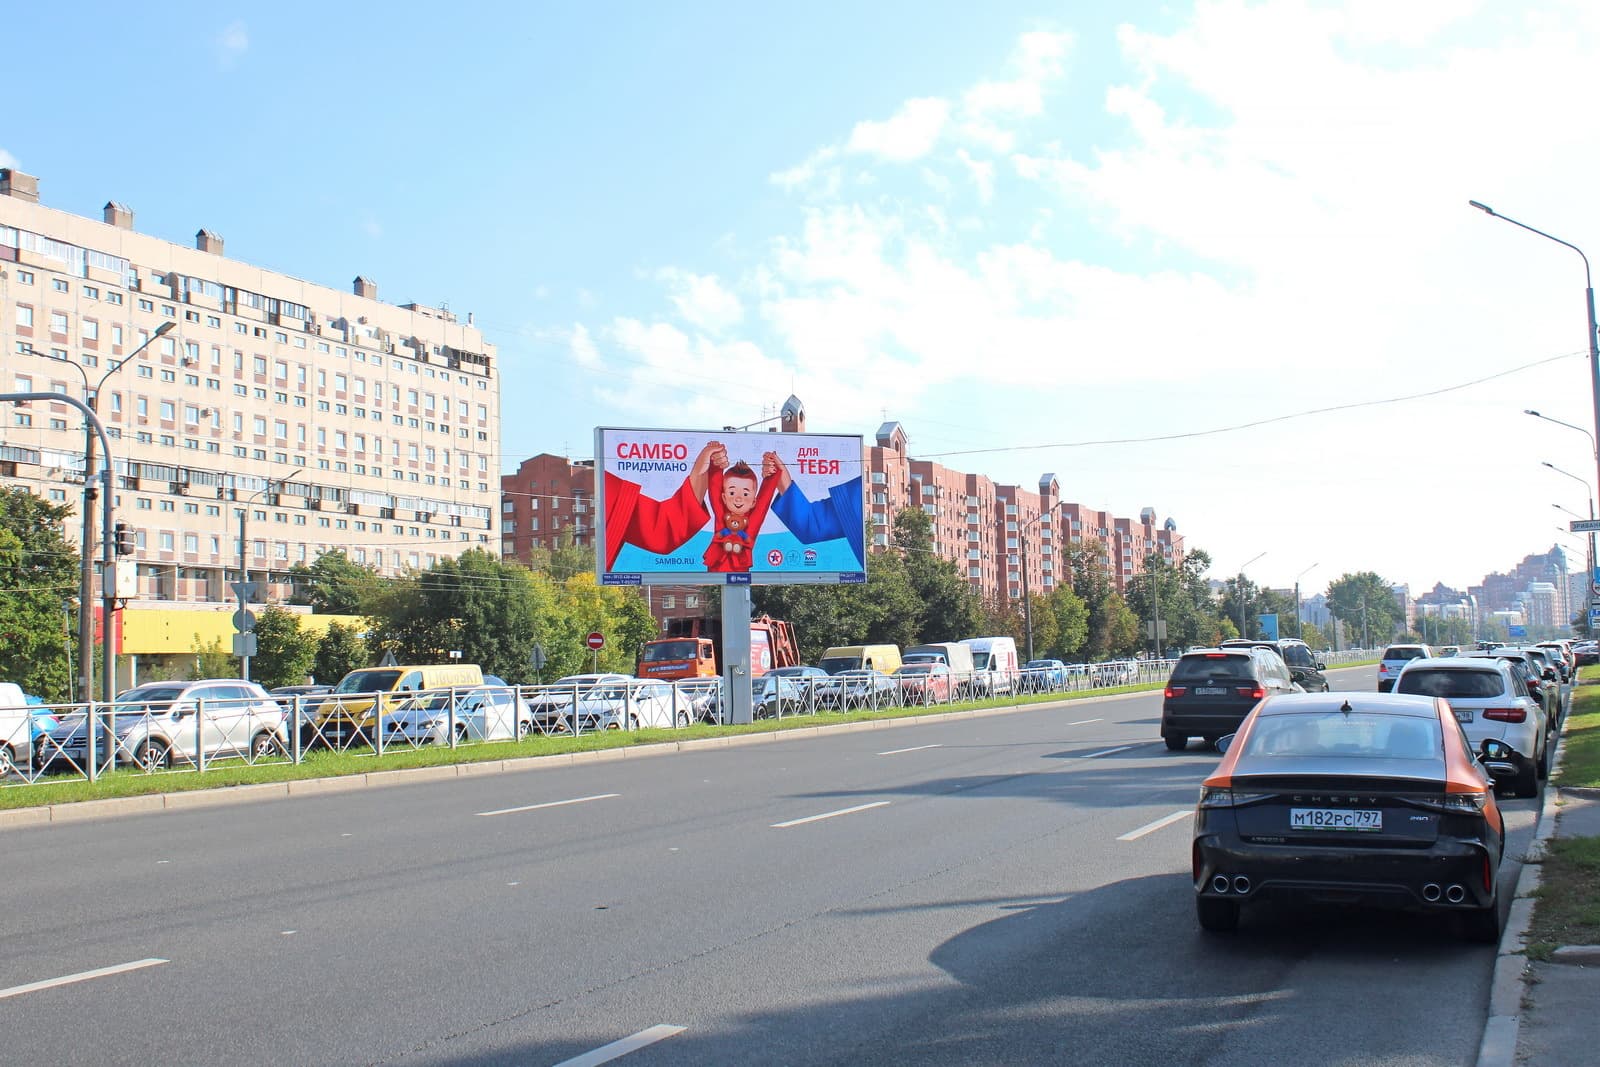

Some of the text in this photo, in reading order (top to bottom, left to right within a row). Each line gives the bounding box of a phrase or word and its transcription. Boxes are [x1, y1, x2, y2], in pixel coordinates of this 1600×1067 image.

[617, 442, 688, 460] САМБО
[797, 447, 819, 458] ДЛЯ
[617, 461, 688, 473] ПРИДУМАНО
[796, 459, 840, 475] ТЕБЯ
[655, 557, 695, 565] SAMBO.RU
[1294, 810, 1379, 826] М182РС 797
